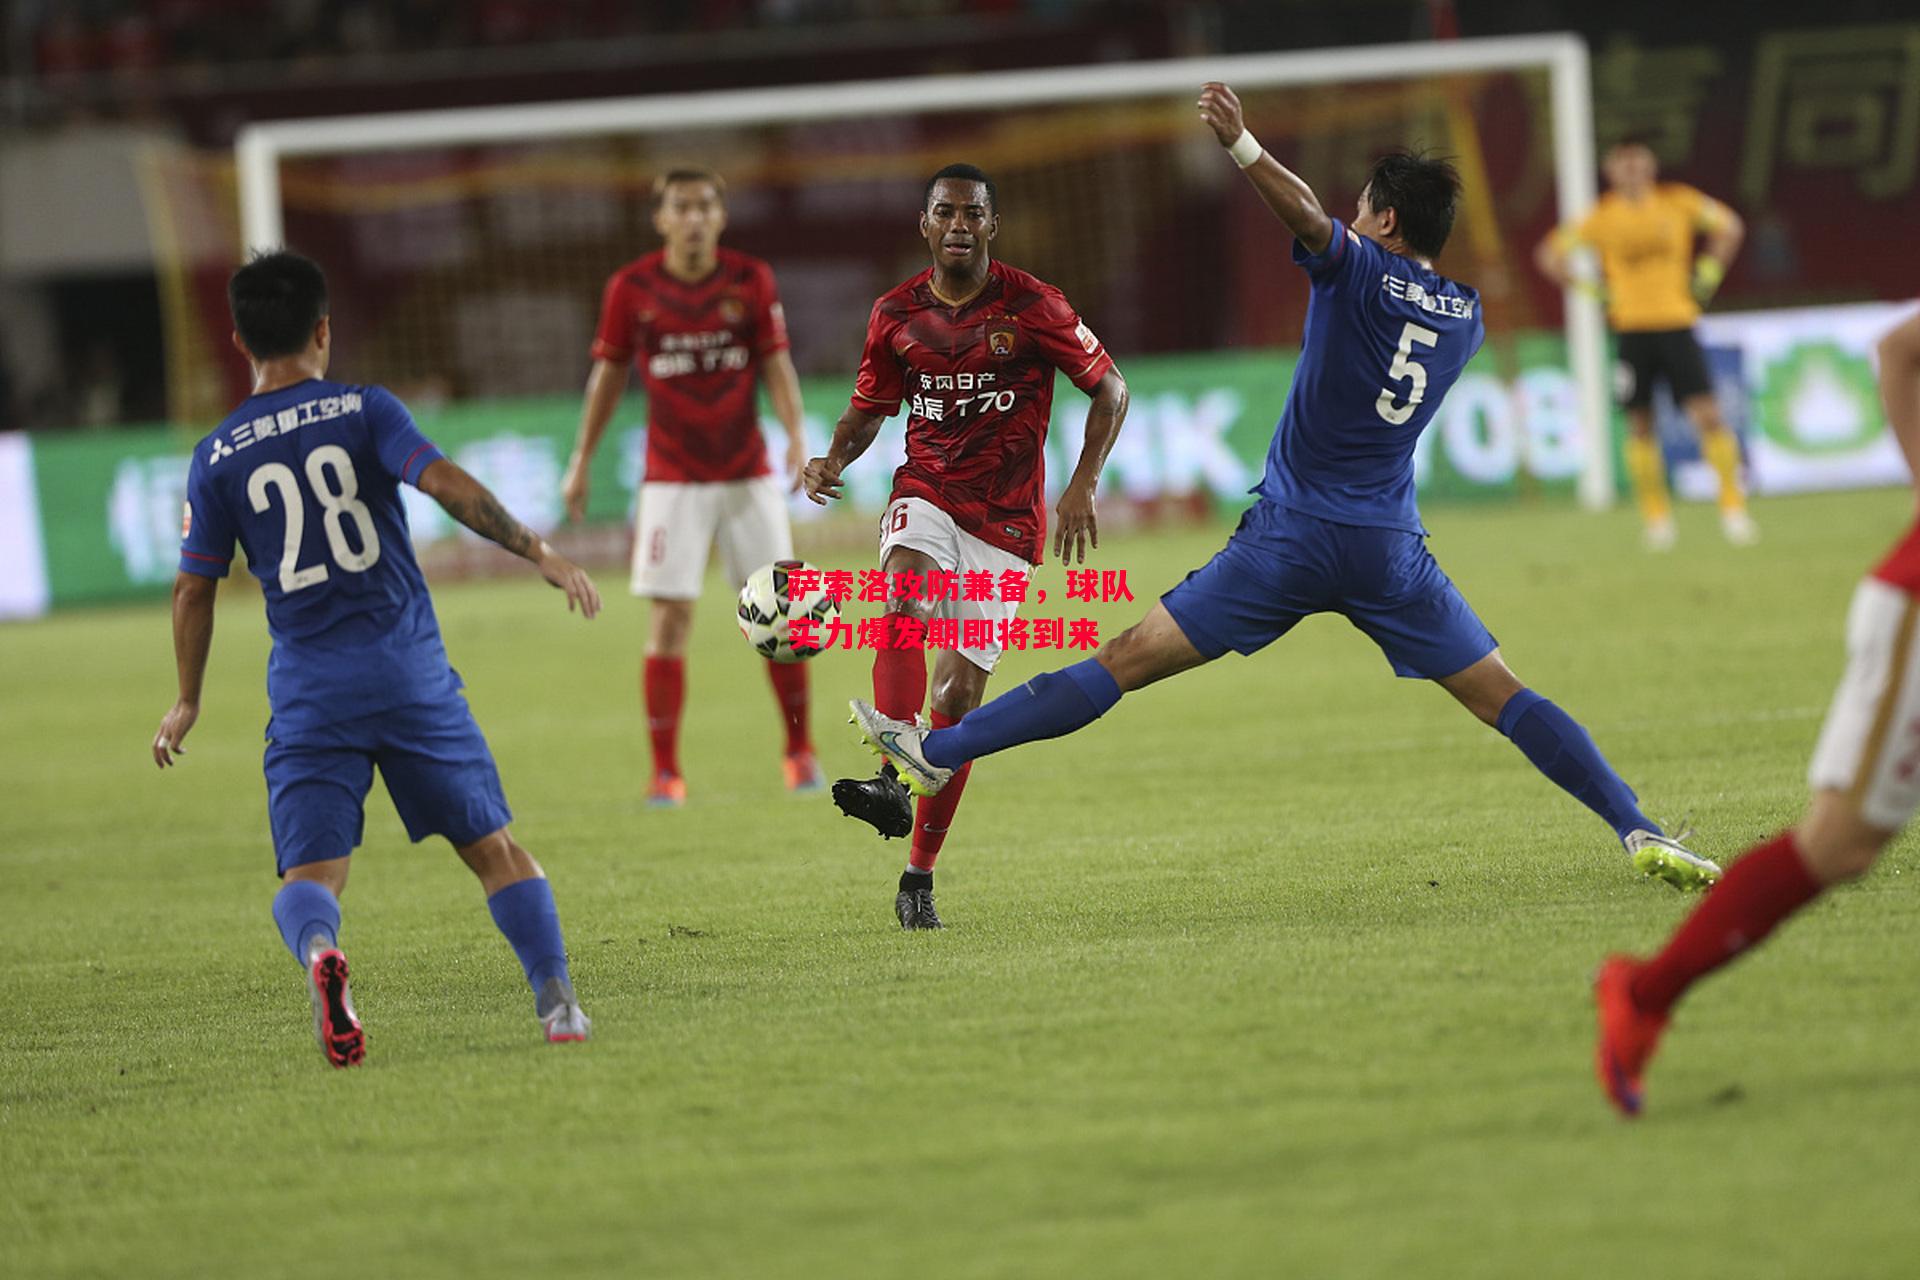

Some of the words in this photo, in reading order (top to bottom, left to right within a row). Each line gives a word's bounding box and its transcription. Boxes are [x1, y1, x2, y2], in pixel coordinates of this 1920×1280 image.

[919, 372, 997, 391] 东风日产
[955, 390, 1016, 417] T70
[1375, 321, 1439, 425] 5
[247, 444, 381, 594] 28
